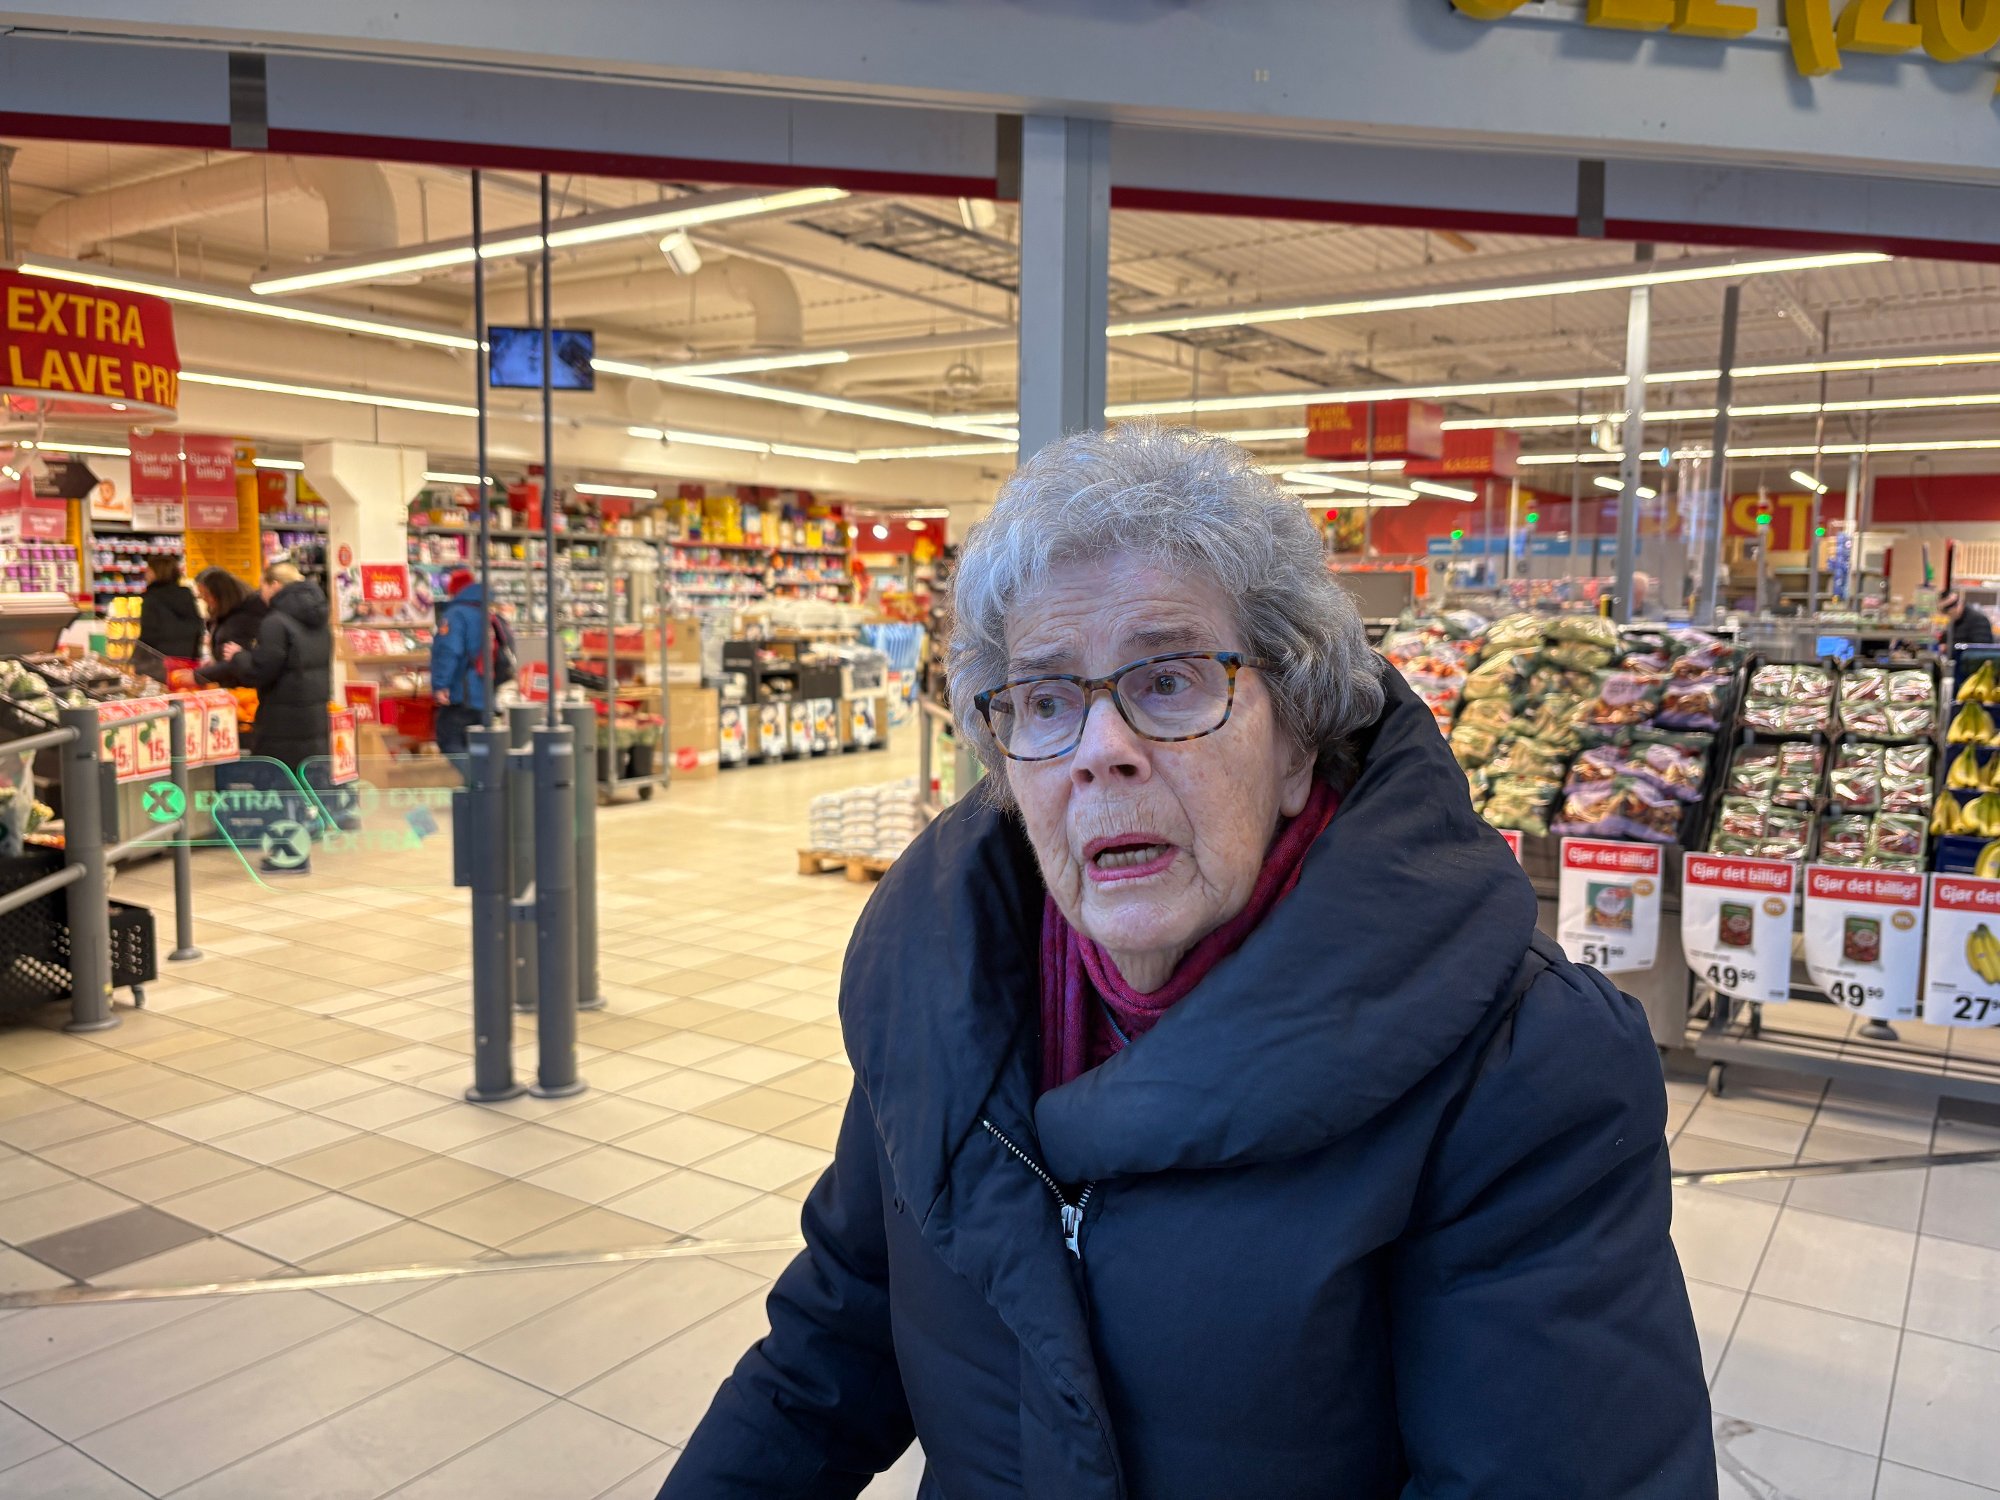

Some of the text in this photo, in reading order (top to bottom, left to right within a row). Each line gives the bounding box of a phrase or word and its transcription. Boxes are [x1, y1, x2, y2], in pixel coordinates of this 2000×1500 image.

[7, 286, 145, 349] EXTRA
[8, 345, 178, 409] LAVE PRI
[1443, 456, 1491, 473] KASSE
[194, 789, 284, 812] EXTRA
[322, 830, 423, 853] EXTRA
[1568, 847, 1655, 870] Gjør det billig!
[1691, 862, 1788, 888] Gjør det billig!
[1813, 874, 1917, 899] Gjør det billig!
[1939, 884, 1974, 904] Gjør
